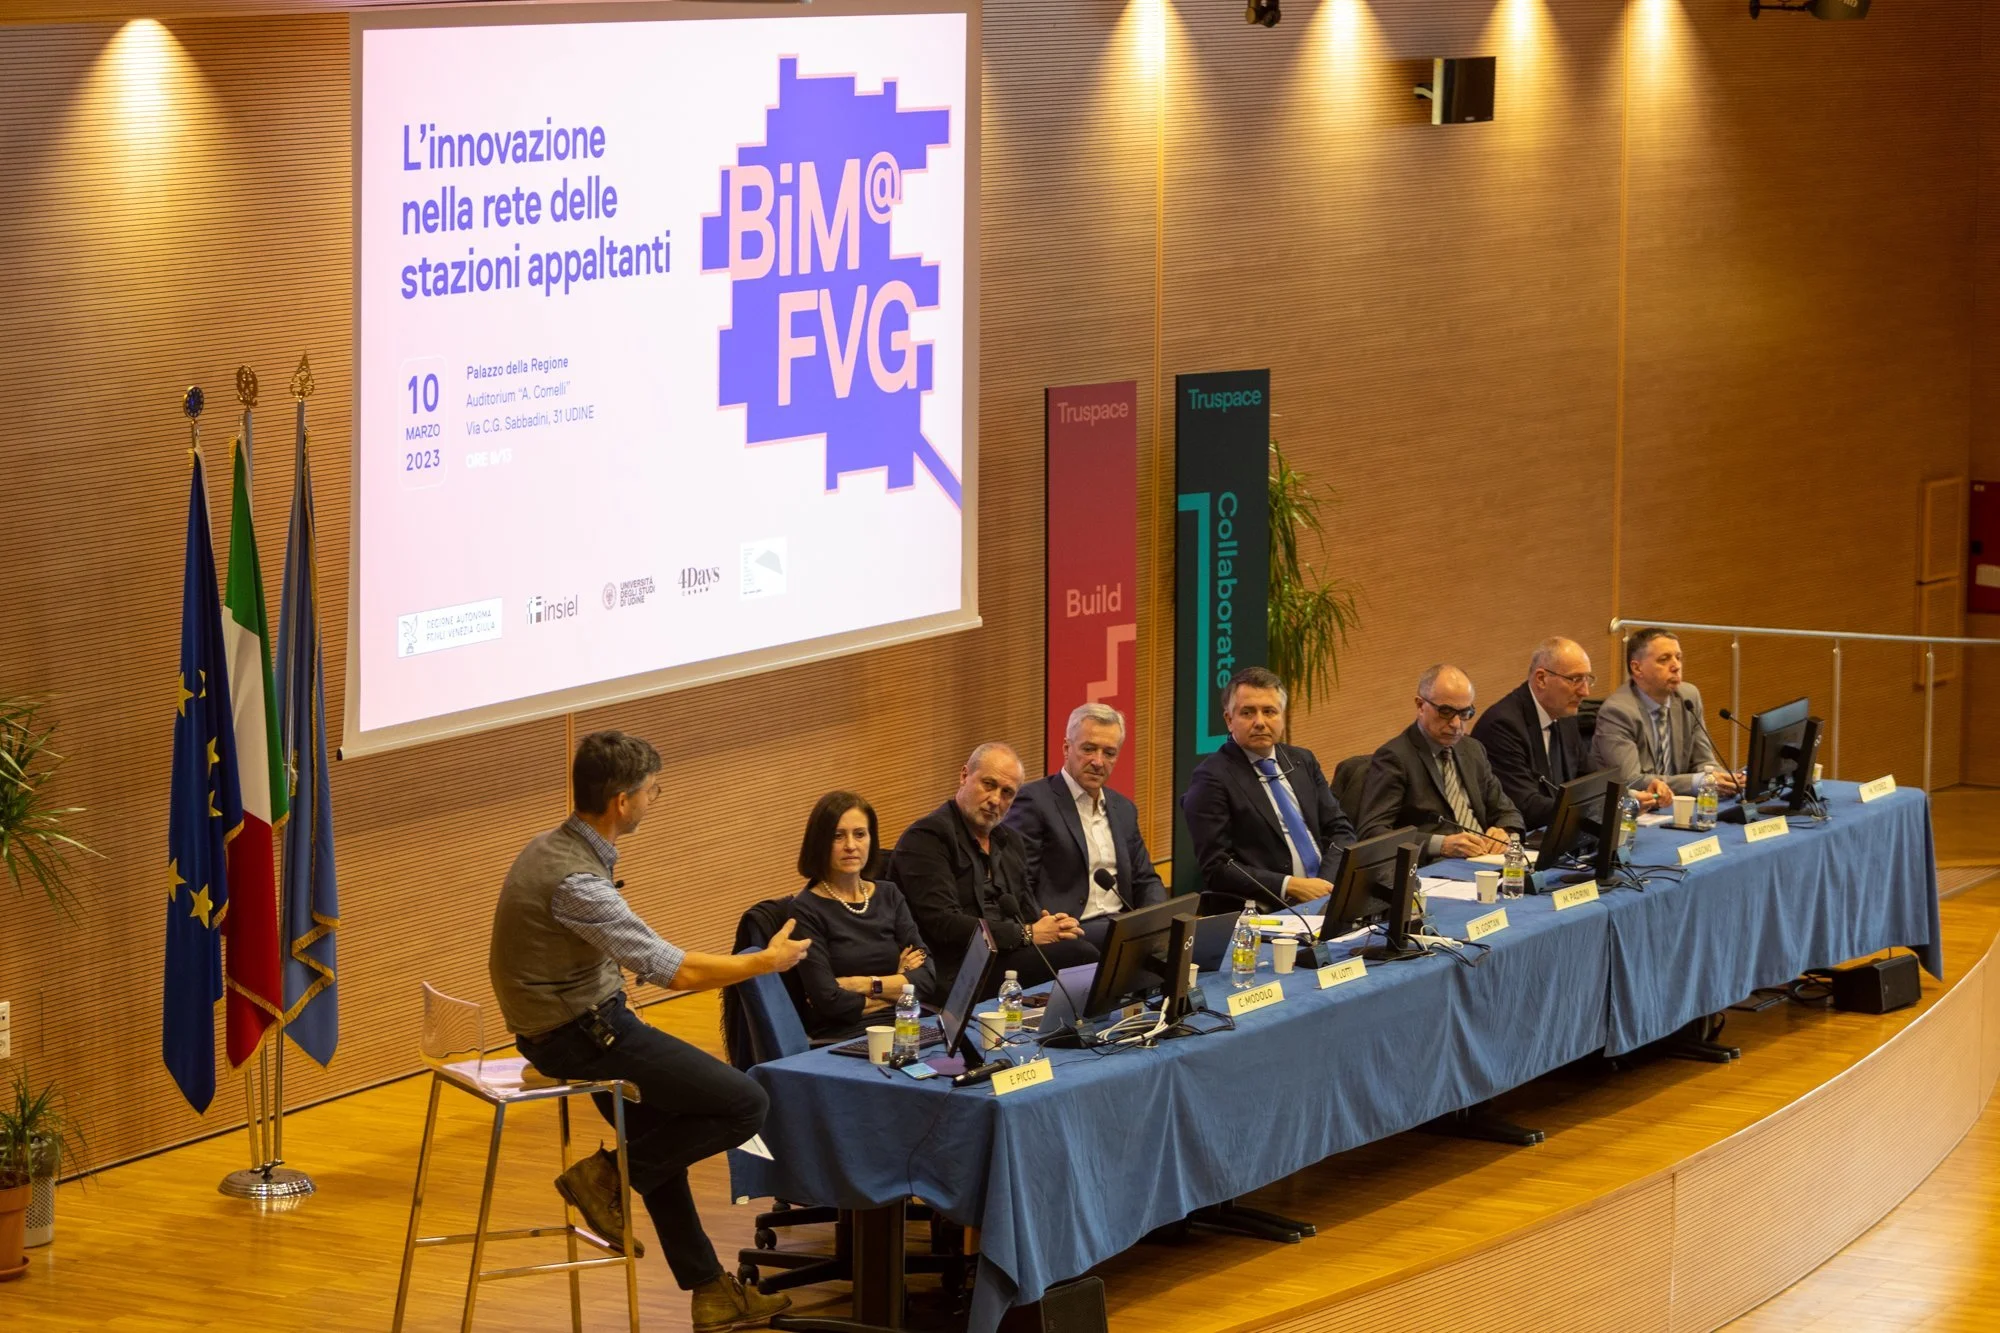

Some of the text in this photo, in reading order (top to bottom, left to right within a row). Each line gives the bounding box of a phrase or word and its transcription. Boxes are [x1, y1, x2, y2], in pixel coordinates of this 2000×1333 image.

[404, 117, 605, 170] L’innovazione
[402, 175, 617, 235] nella rete delle
[401, 230, 670, 299] stazioni appaltanti
[778, 281, 917, 406] FVG
[467, 357, 568, 380] Palazzo della Regione
[408, 373, 439, 414] 10
[466, 390, 515, 408] Auditorium
[1188, 388, 1262, 413] Truspace
[466, 405, 595, 435] Via C.G. Sabbadini, 31 UDINE
[1058, 400, 1129, 427] Truspace
[406, 424, 440, 440] MARZO
[406, 449, 440, 471] 2023
[677, 566, 720, 589] 4Days
[1216, 491, 1239, 689] Collaborate
[544, 594, 578, 622] insiel
[1066, 583, 1122, 618] Build
[1245, 988, 1273, 1006] MODOLO
[1017, 1069, 1037, 1084] PICCO
